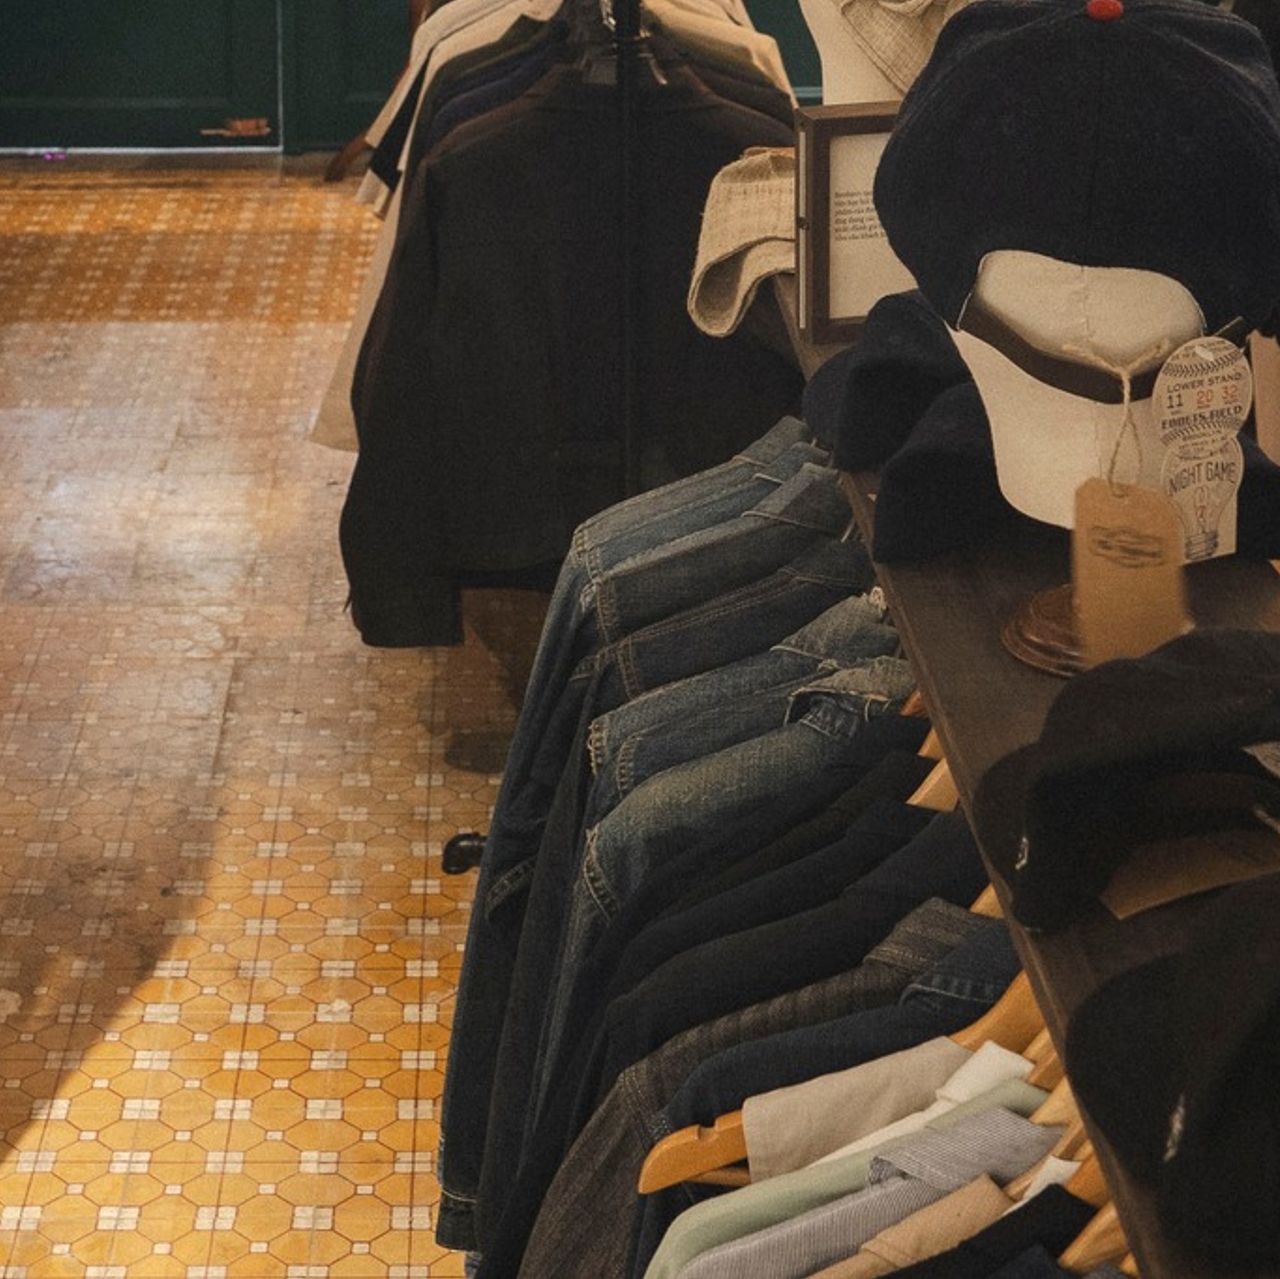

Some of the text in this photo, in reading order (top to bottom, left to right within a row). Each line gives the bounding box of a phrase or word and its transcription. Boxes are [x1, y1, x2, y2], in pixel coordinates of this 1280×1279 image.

[1167, 372, 1242, 394] LOWER STAND
[1166, 385, 1239, 410] 11 20 32
[1168, 459, 1237, 497] NIGHT GAME
